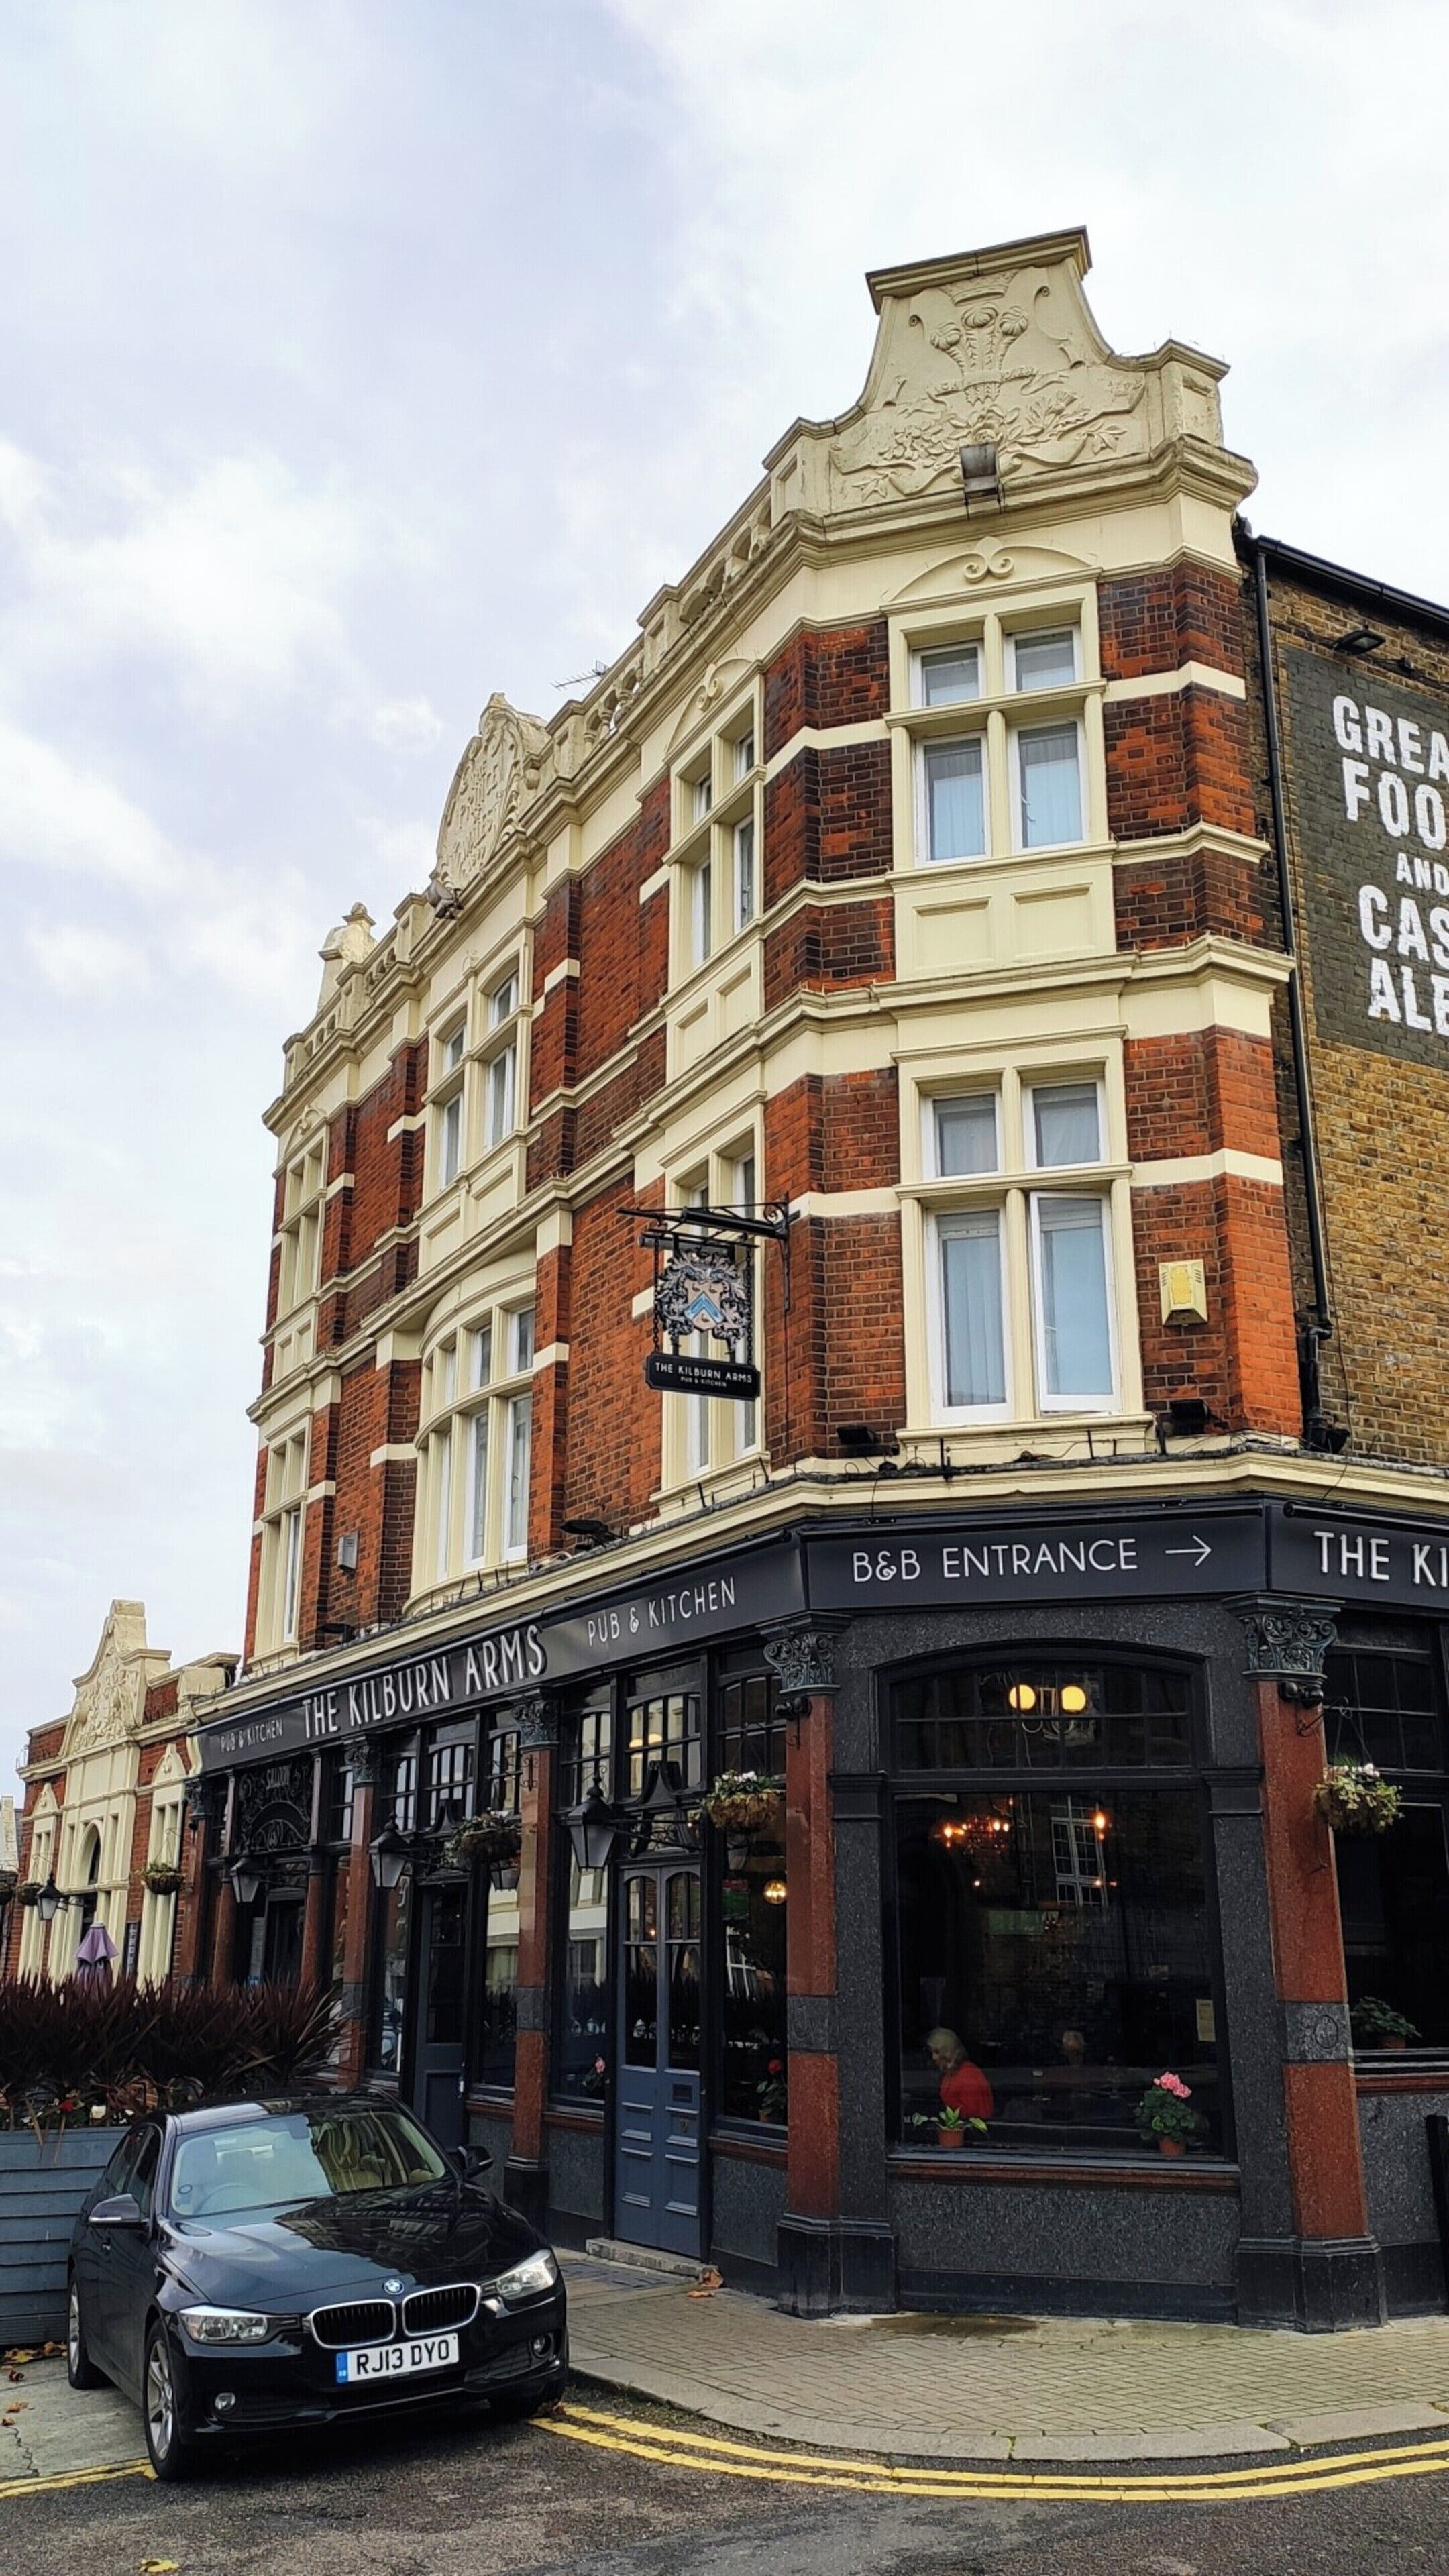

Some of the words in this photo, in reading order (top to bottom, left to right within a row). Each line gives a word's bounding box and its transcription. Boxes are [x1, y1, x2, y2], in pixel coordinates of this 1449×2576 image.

[655, 1362, 673, 1373] THE
[678, 1366, 721, 1379] KILBURN
[725, 1372, 752, 1383] ARMS
[700, 1379, 727, 1387] KITCHEN
[853, 1550, 921, 1583] B&B
[943, 1538, 1138, 1578] ENTRANCE
[1313, 1531, 1391, 1580] THE
[1412, 1544, 1448, 1587] KI
[588, 1613, 621, 1646] PUB
[629, 1606, 640, 1633] &
[648, 1577, 736, 1627] KITCHEN
[302, 1690, 338, 1737] THE
[349, 1655, 452, 1726] KILBURN
[464, 1623, 547, 1695] ARMS
[221, 1733, 235, 1752] PUB
[246, 1719, 282, 1746] KITCHEN
[356, 2347, 402, 2375] RJ13
[411, 2339, 449, 2366] DYO
